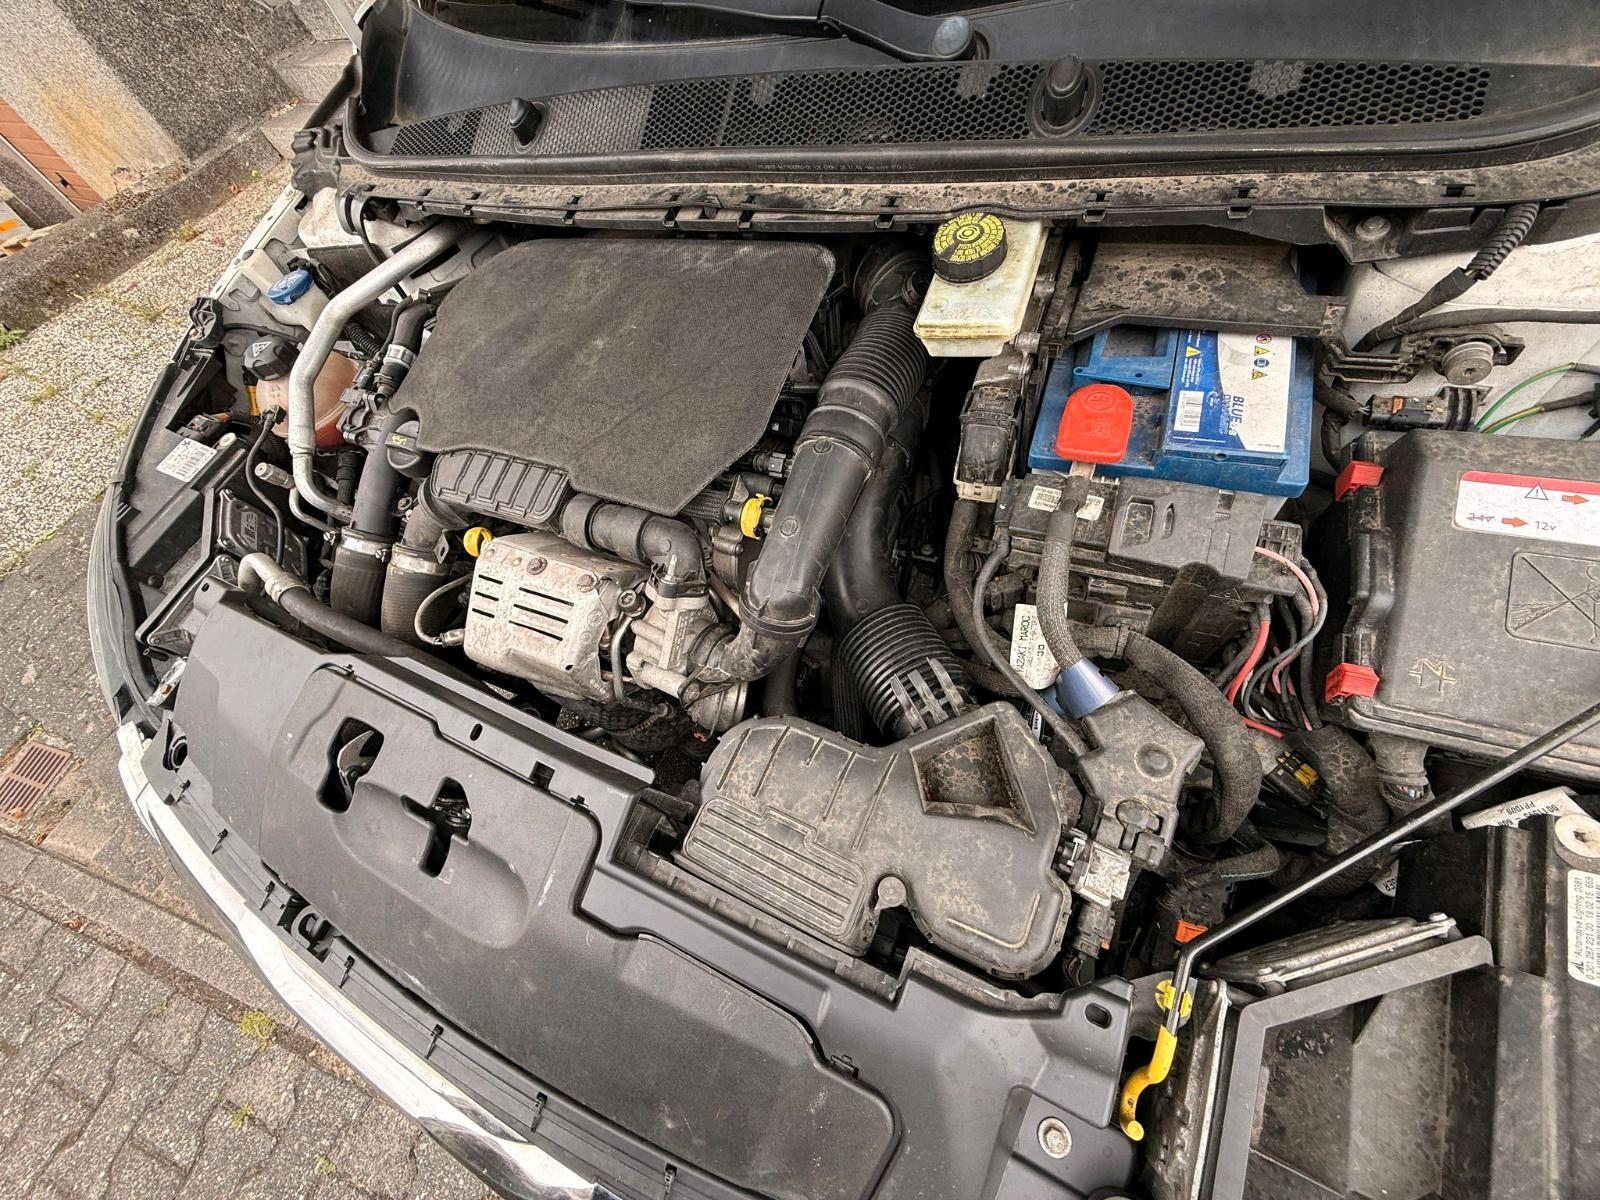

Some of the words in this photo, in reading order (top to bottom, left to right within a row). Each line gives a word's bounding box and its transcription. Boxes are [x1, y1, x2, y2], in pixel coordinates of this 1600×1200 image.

[1231, 396, 1244, 423] BLUE
[1535, 520, 1556, 531] 12v
[1020, 616, 1031, 641] MAROC
[1016, 645, 1026, 672] YAZAKI
[1573, 895, 1584, 920] Lighting
[1574, 920, 1583, 959] Automotive
